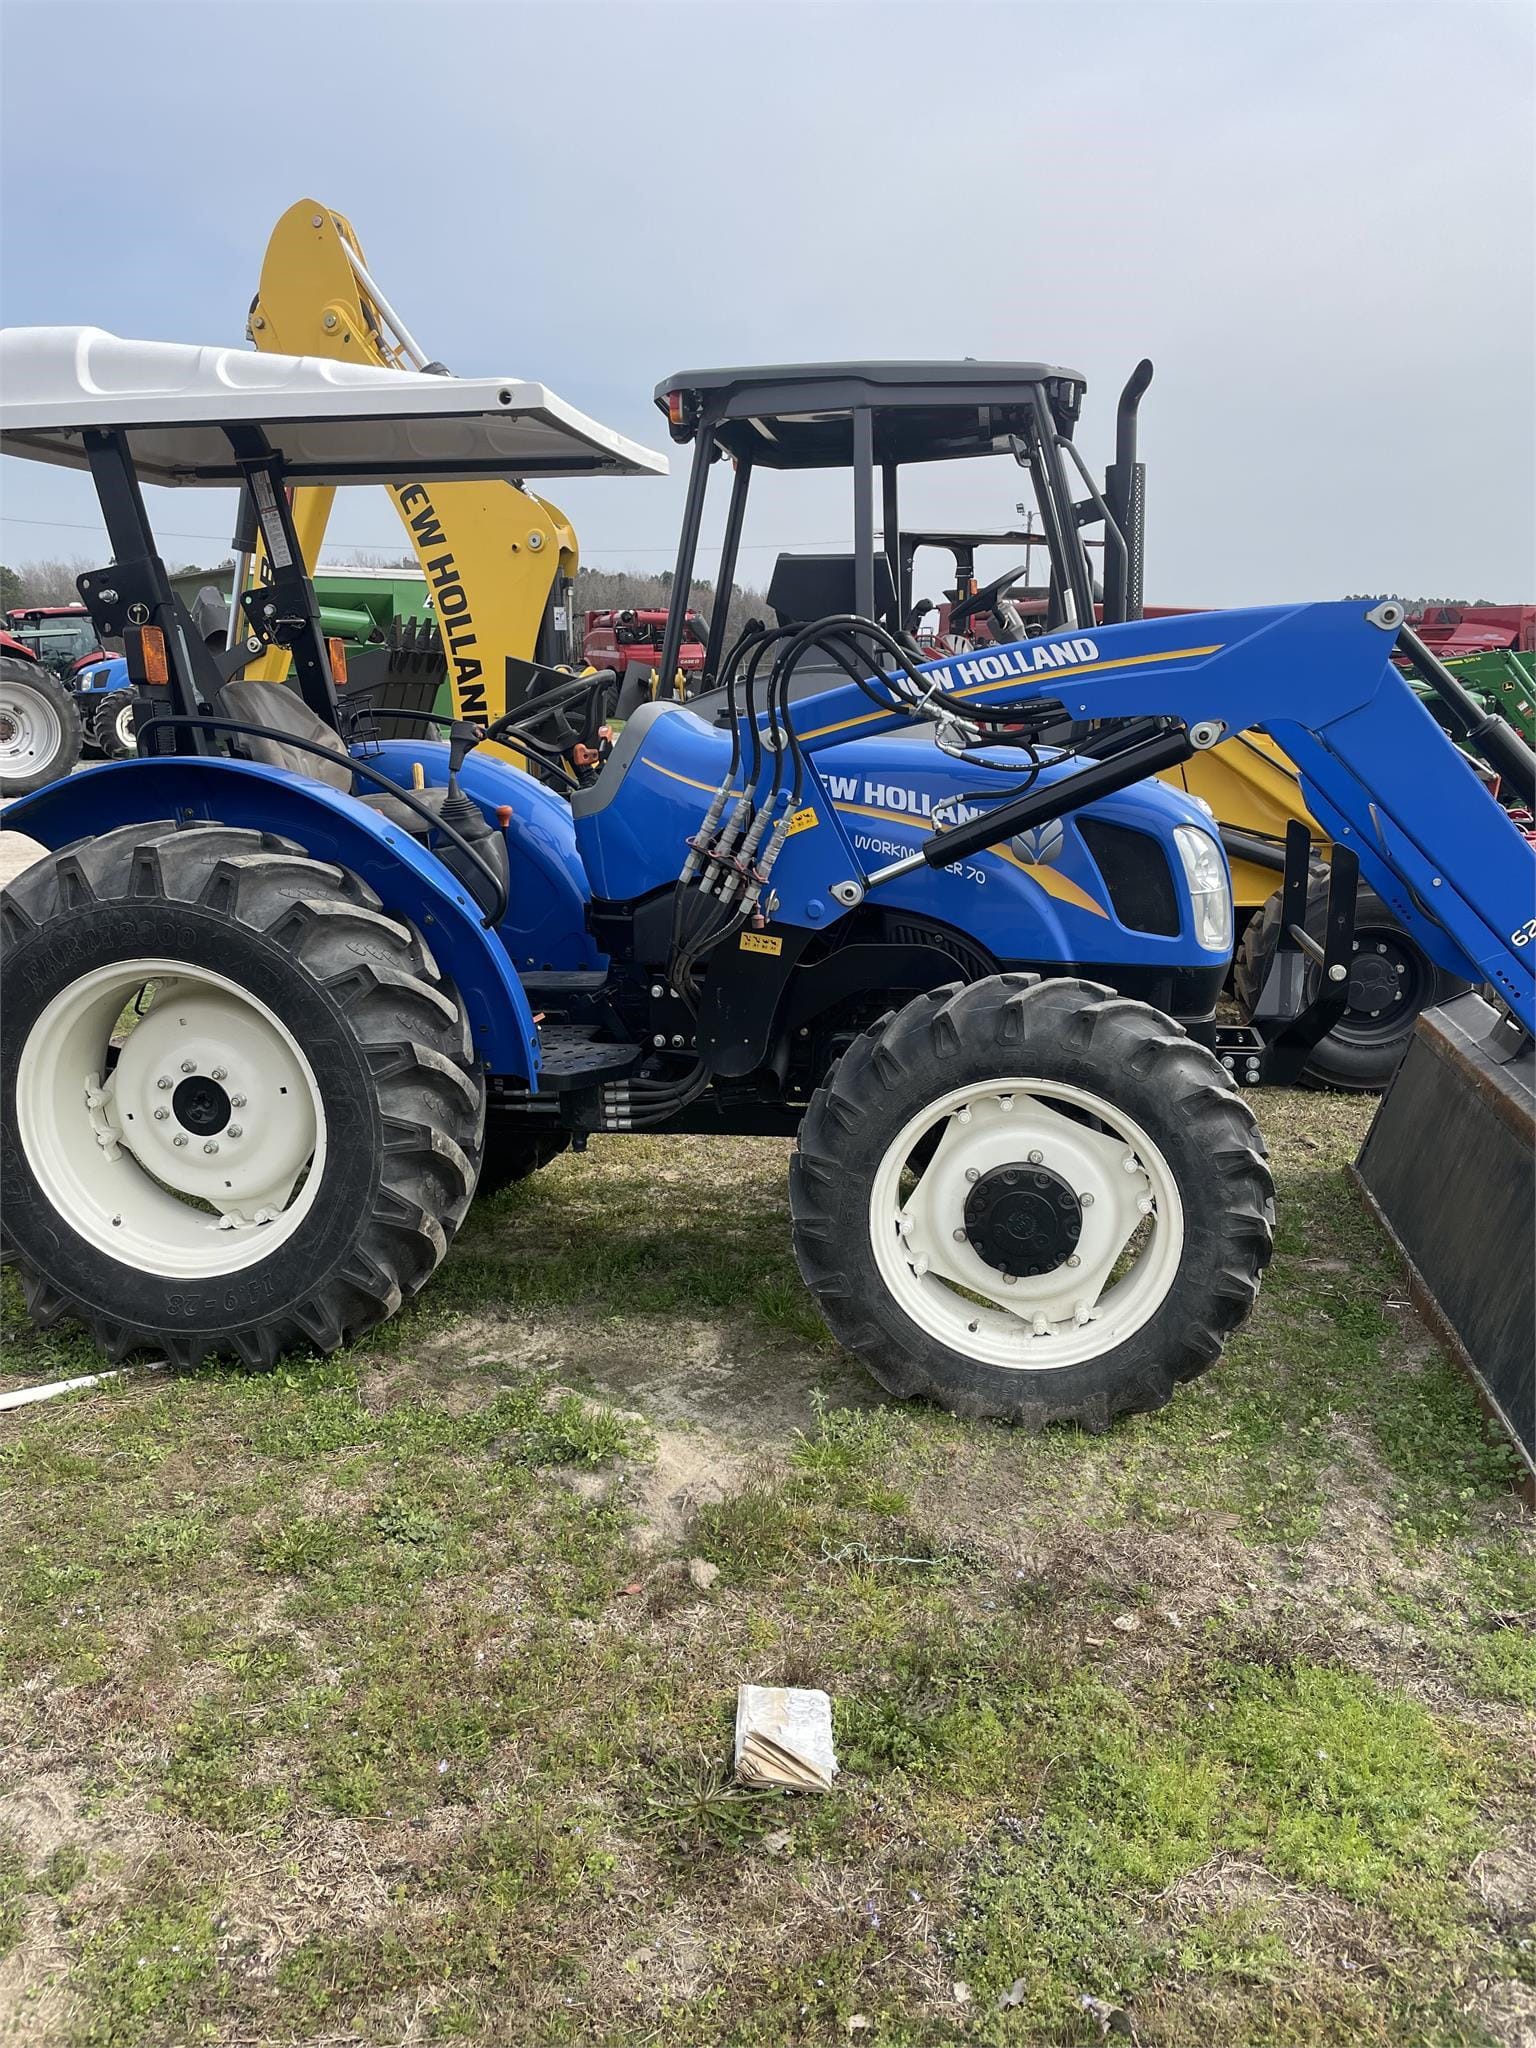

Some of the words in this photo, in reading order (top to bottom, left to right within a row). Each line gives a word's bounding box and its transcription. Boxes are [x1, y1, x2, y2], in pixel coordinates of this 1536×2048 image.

[391, 482, 447, 548] EW
[956, 638, 1099, 685] HOLLAND
[966, 866, 987, 885] 70
[1511, 918, 1536, 947] 62
